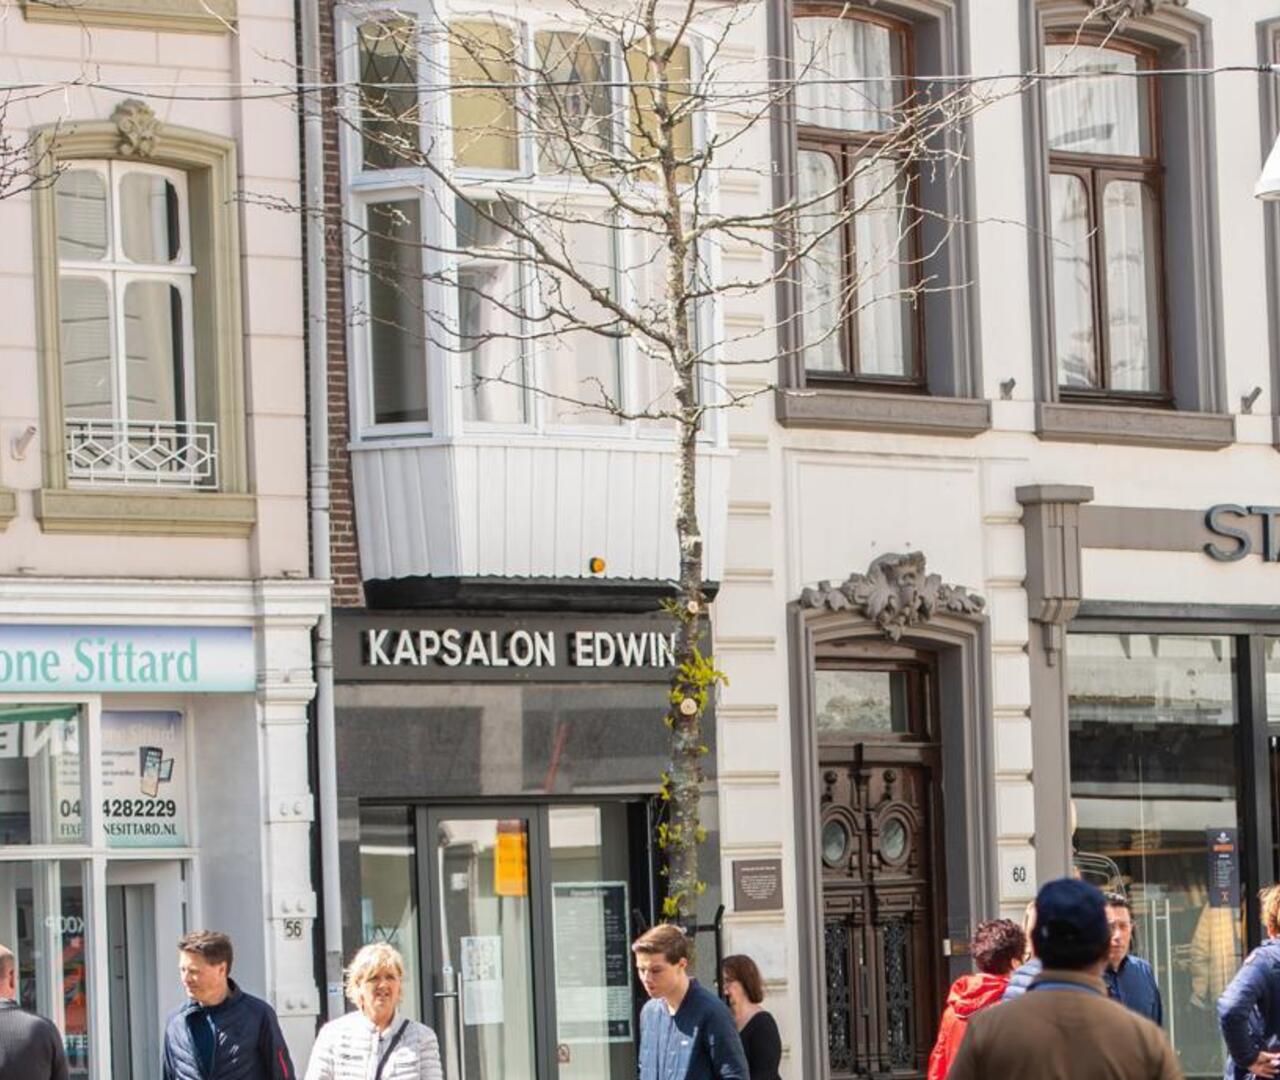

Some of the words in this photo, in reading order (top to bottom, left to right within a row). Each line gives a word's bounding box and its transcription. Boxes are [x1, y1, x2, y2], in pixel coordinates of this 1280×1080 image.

[74, 636, 199, 684] Sittard
[369, 628, 556, 667] KAPSALON
[575, 631, 676, 668] EDWIN
[1013, 866, 1026, 882] 60
[286, 920, 302, 937] 56
